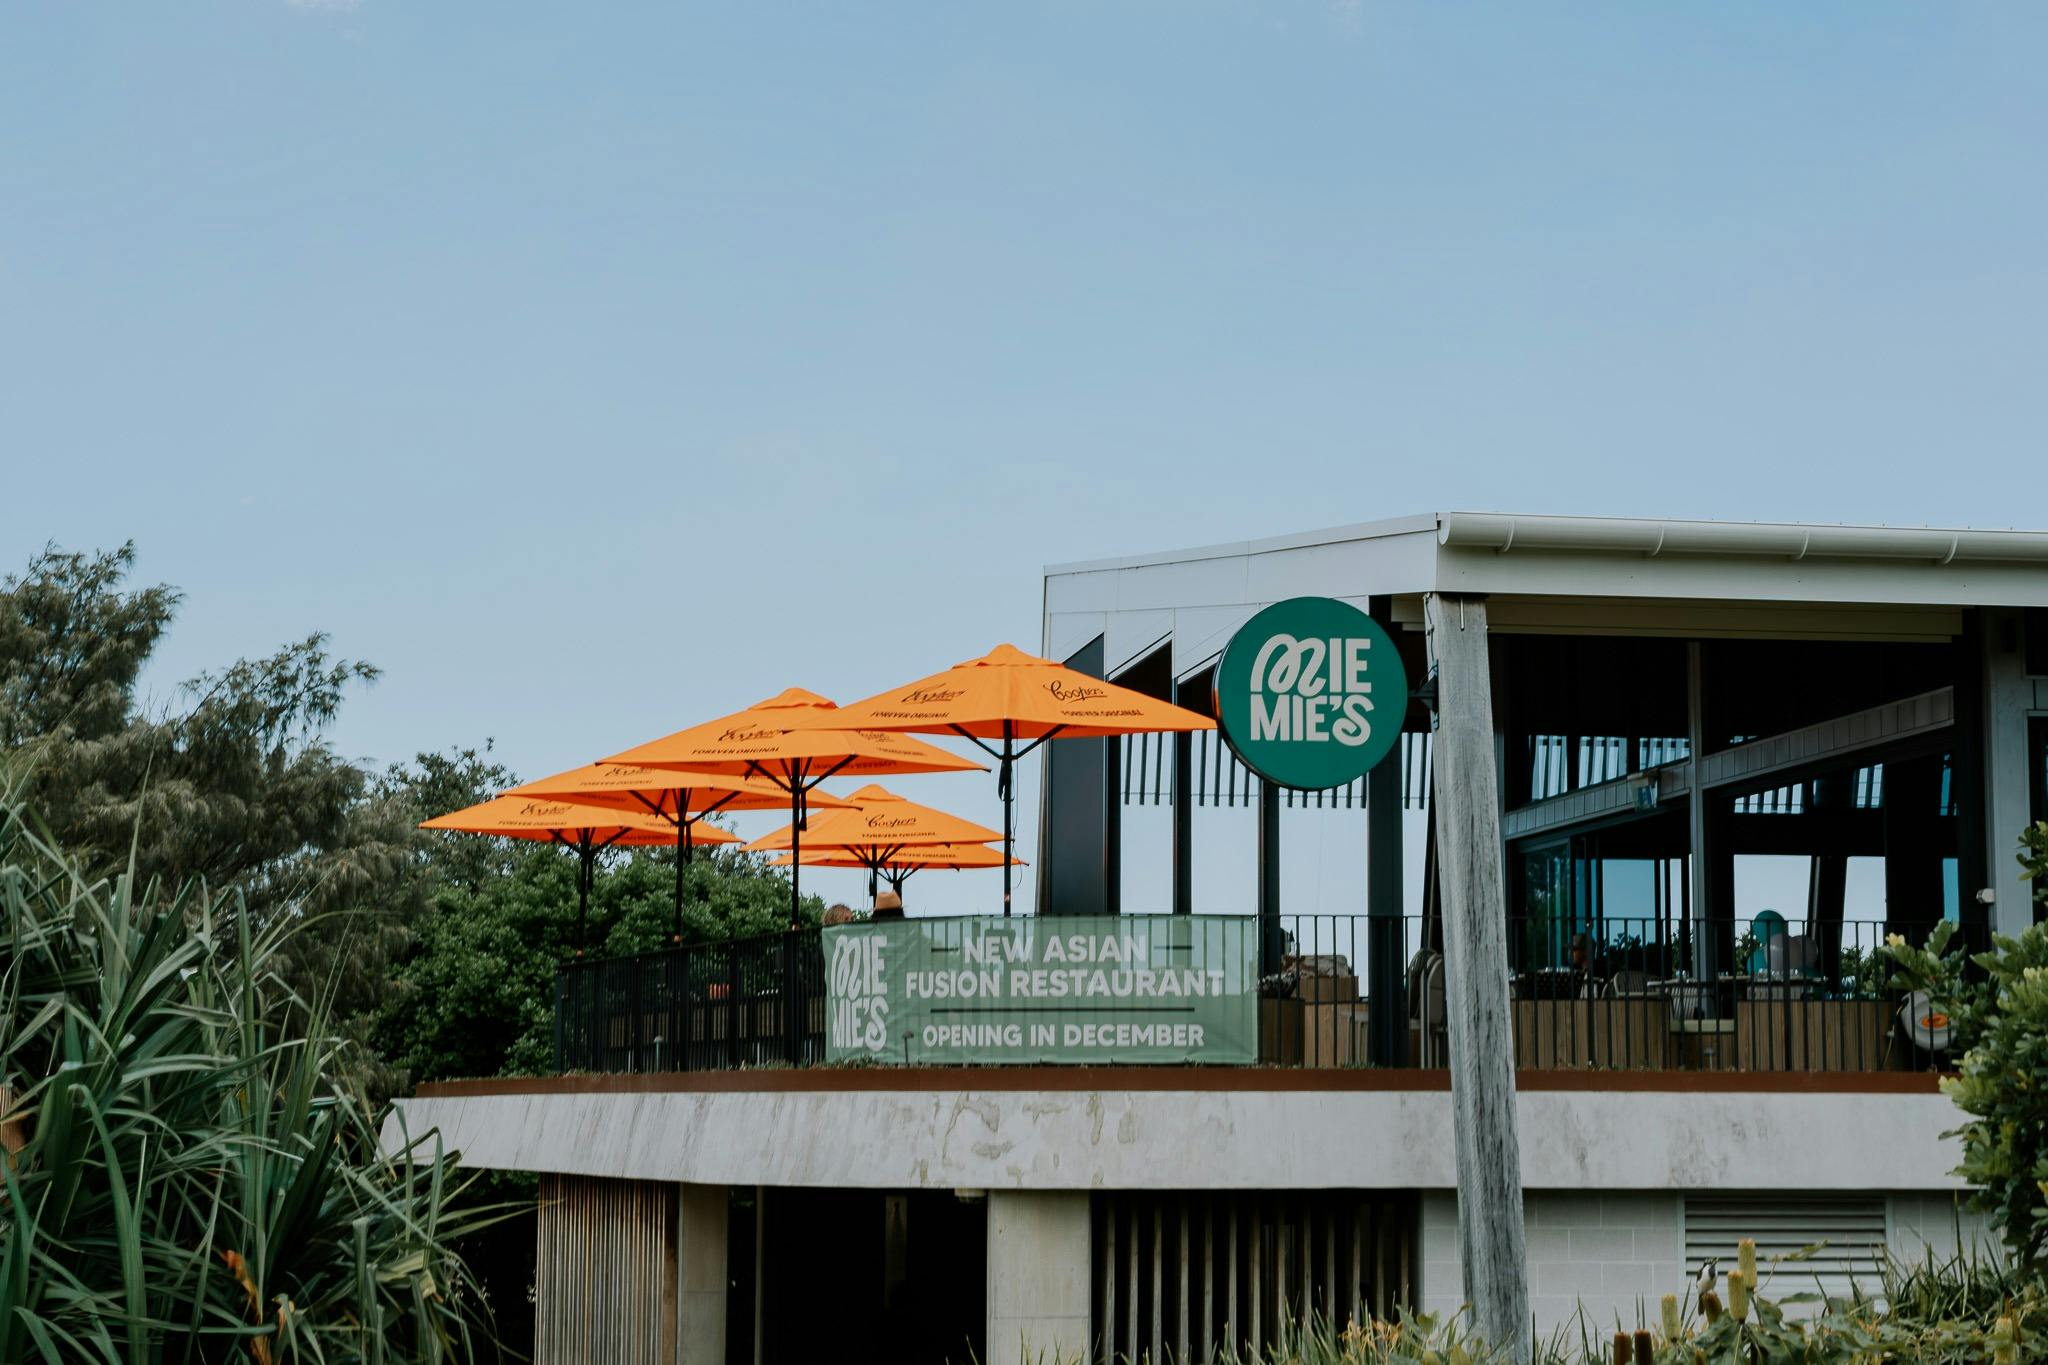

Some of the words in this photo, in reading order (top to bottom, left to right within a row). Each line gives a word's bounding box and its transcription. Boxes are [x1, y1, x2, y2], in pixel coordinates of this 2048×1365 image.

[1250, 633, 1372, 697] MIE
[1250, 694, 1375, 747] MIE'S
[830, 934, 888, 1000] MIE
[964, 935, 1034, 964] NEW
[1042, 934, 1147, 963] ASIAN
[906, 969, 1000, 999] FUSION
[1010, 968, 1224, 998] RESTAURANT
[922, 1023, 1022, 1048] OPENING
[1030, 1023, 1055, 1047] IN
[1063, 1023, 1204, 1048] DECEMBER
